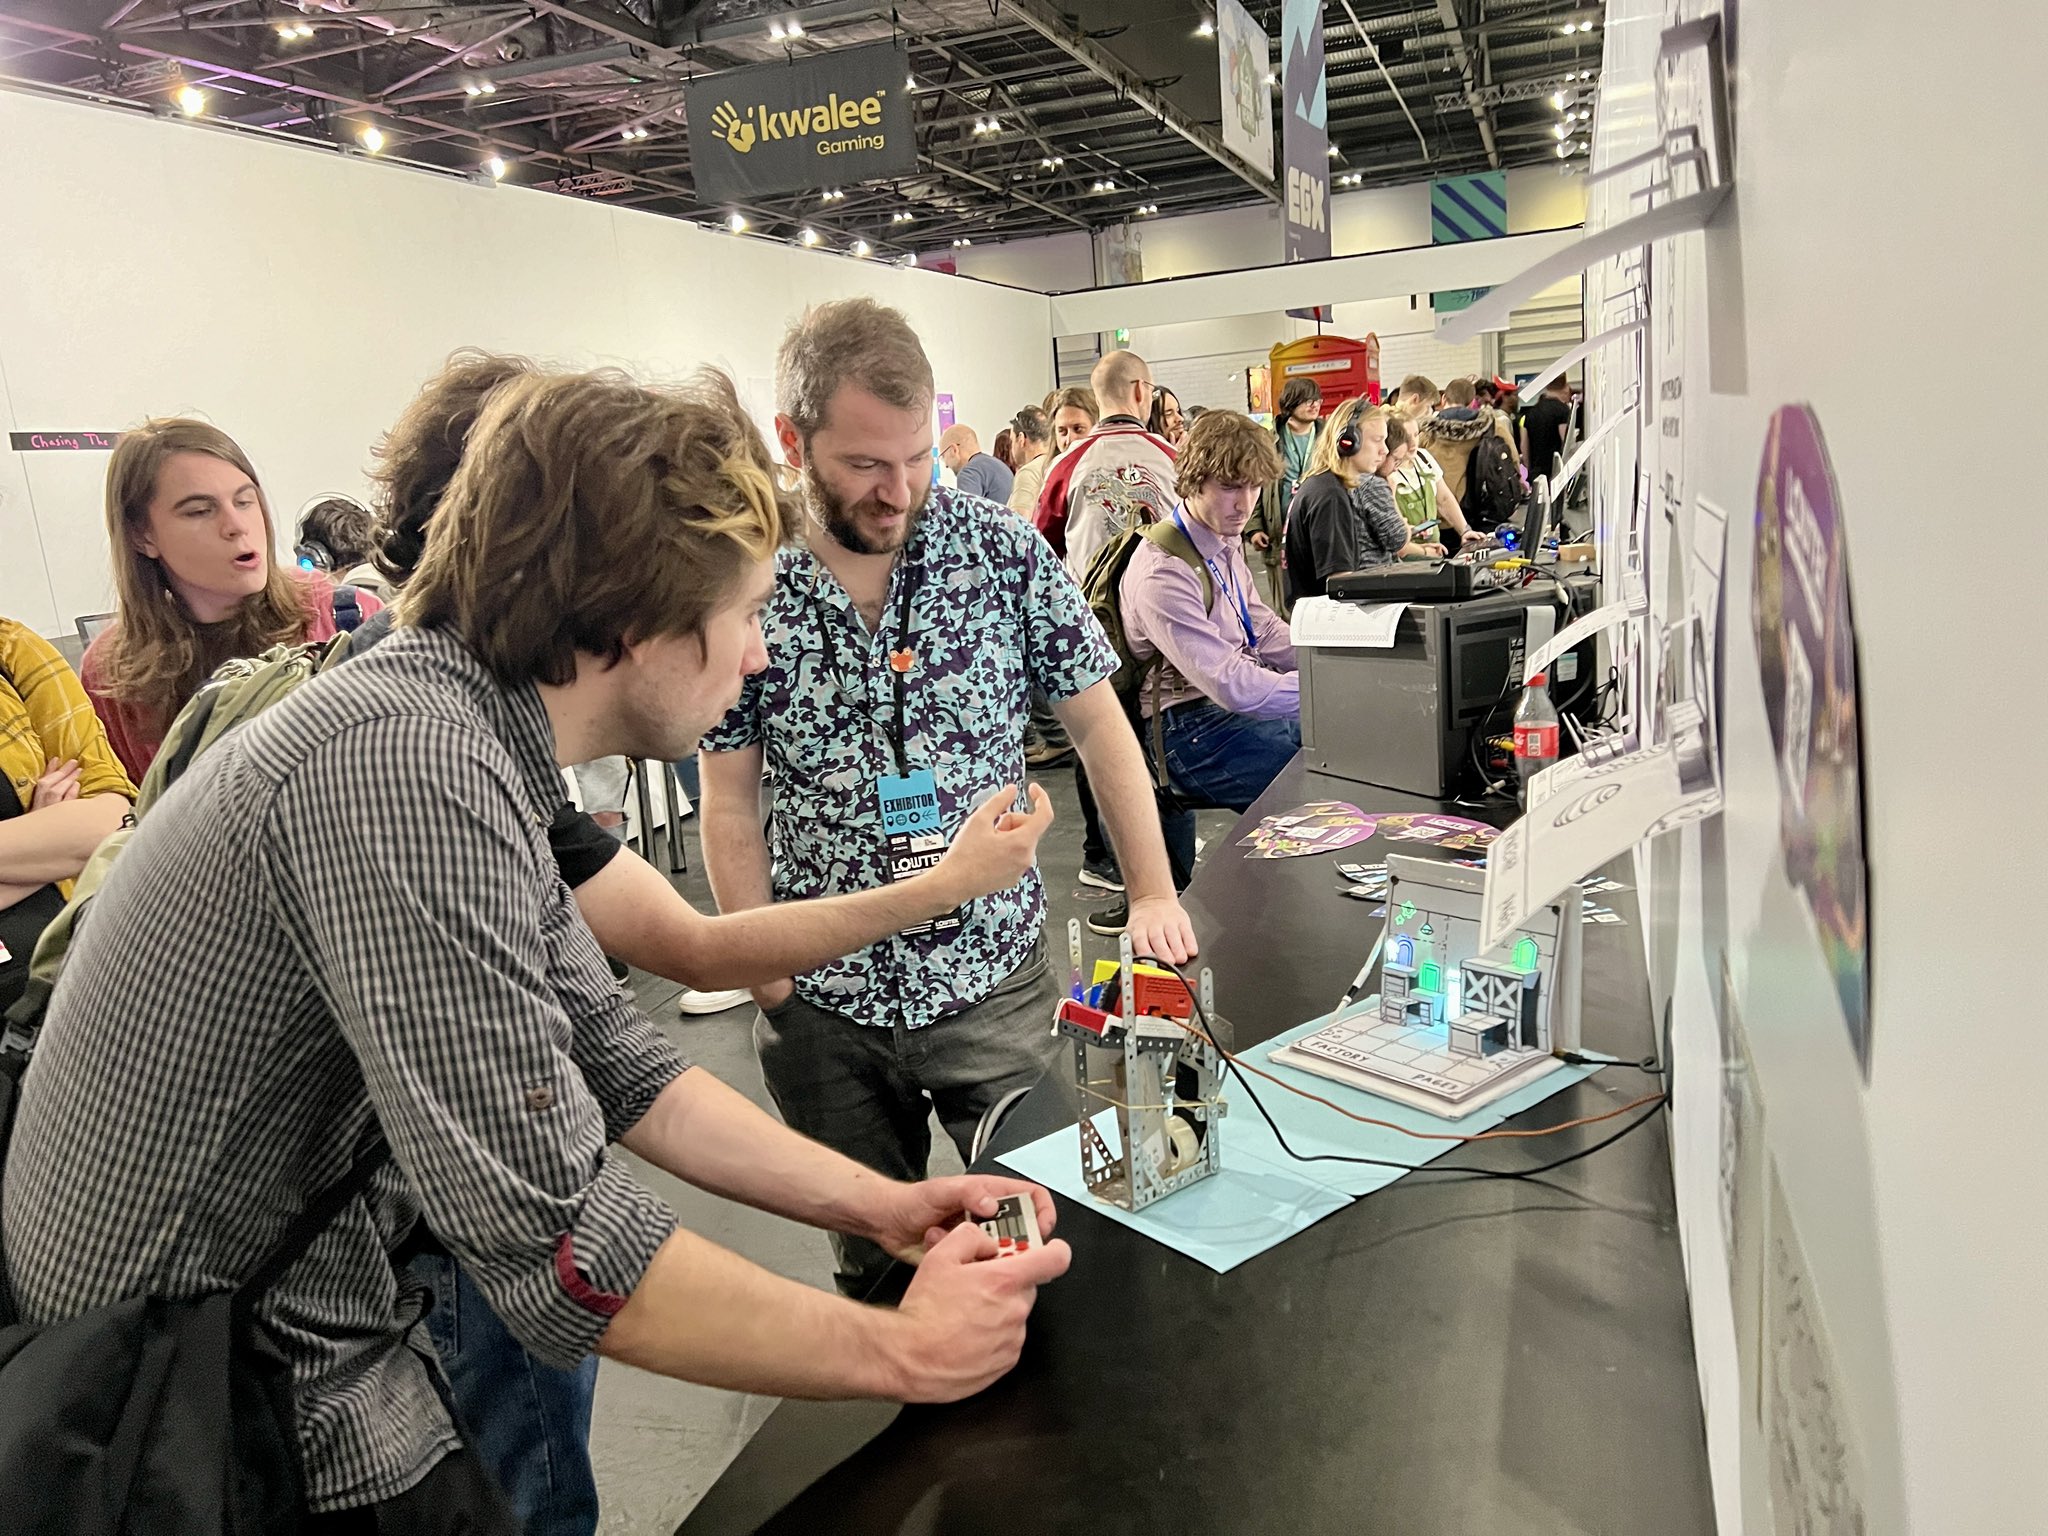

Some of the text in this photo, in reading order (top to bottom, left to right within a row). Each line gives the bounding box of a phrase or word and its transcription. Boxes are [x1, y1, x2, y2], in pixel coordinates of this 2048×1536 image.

[758, 93, 882, 141] kwalee
[816, 133, 885, 156] Gaming
[1288, 166, 1325, 233] EGX
[30, 433, 109, 450] Chasing The
[883, 793, 935, 814] EXHIBITOR
[1311, 1041, 1459, 1091] FACTORY PAGES
